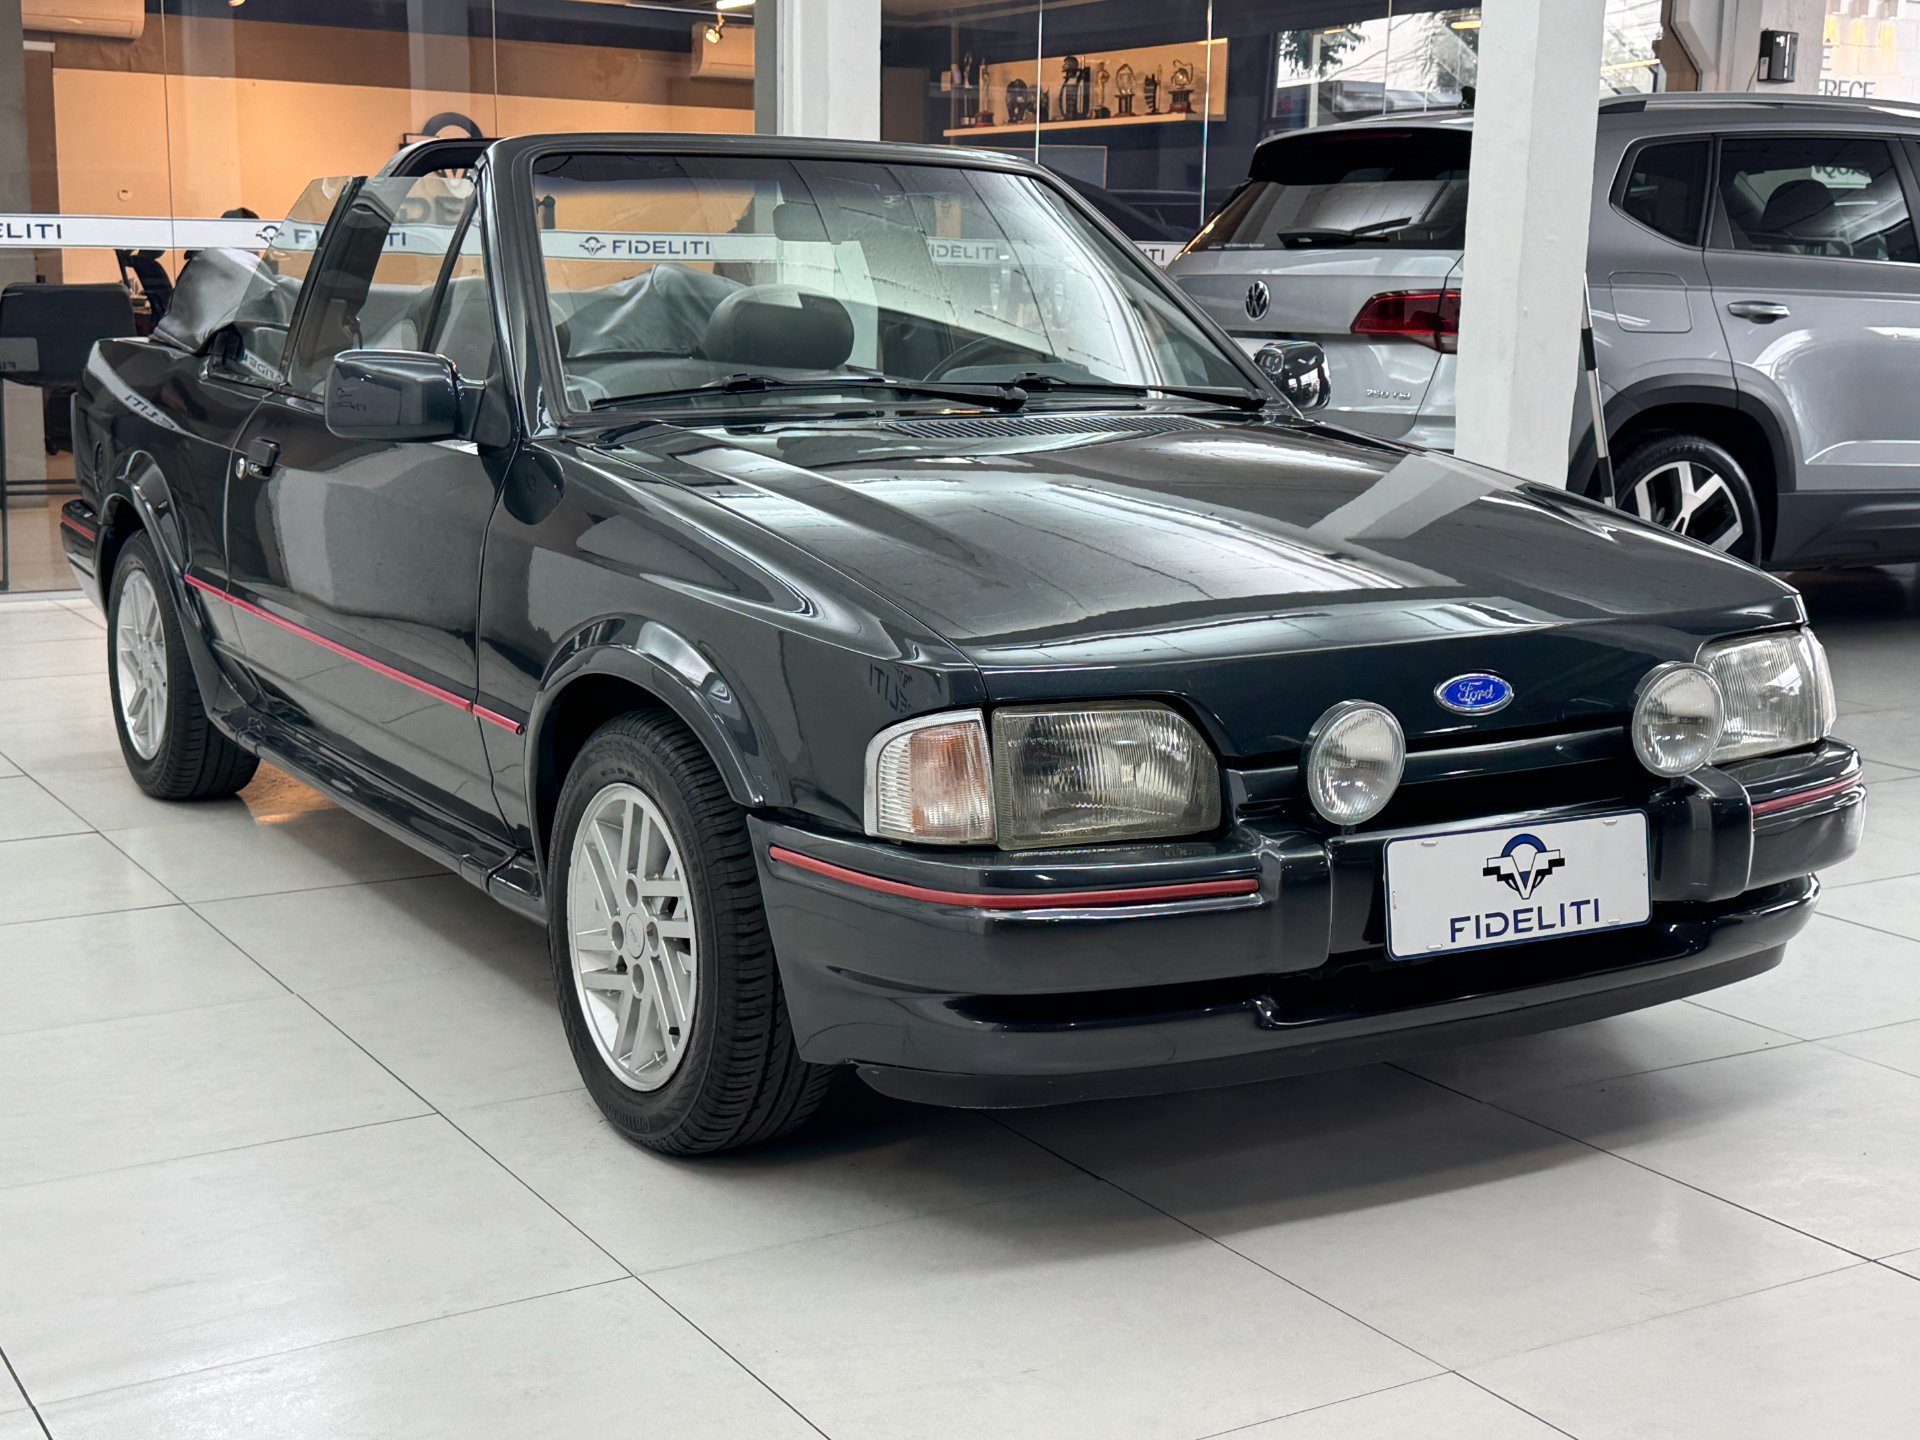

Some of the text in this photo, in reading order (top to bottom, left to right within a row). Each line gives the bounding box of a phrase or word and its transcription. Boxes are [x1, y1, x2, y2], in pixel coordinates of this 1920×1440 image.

[612, 239, 710, 255] FIDELITI
[1457, 681, 1496, 704] Ford
[1450, 898, 1600, 943] FIDELITI
